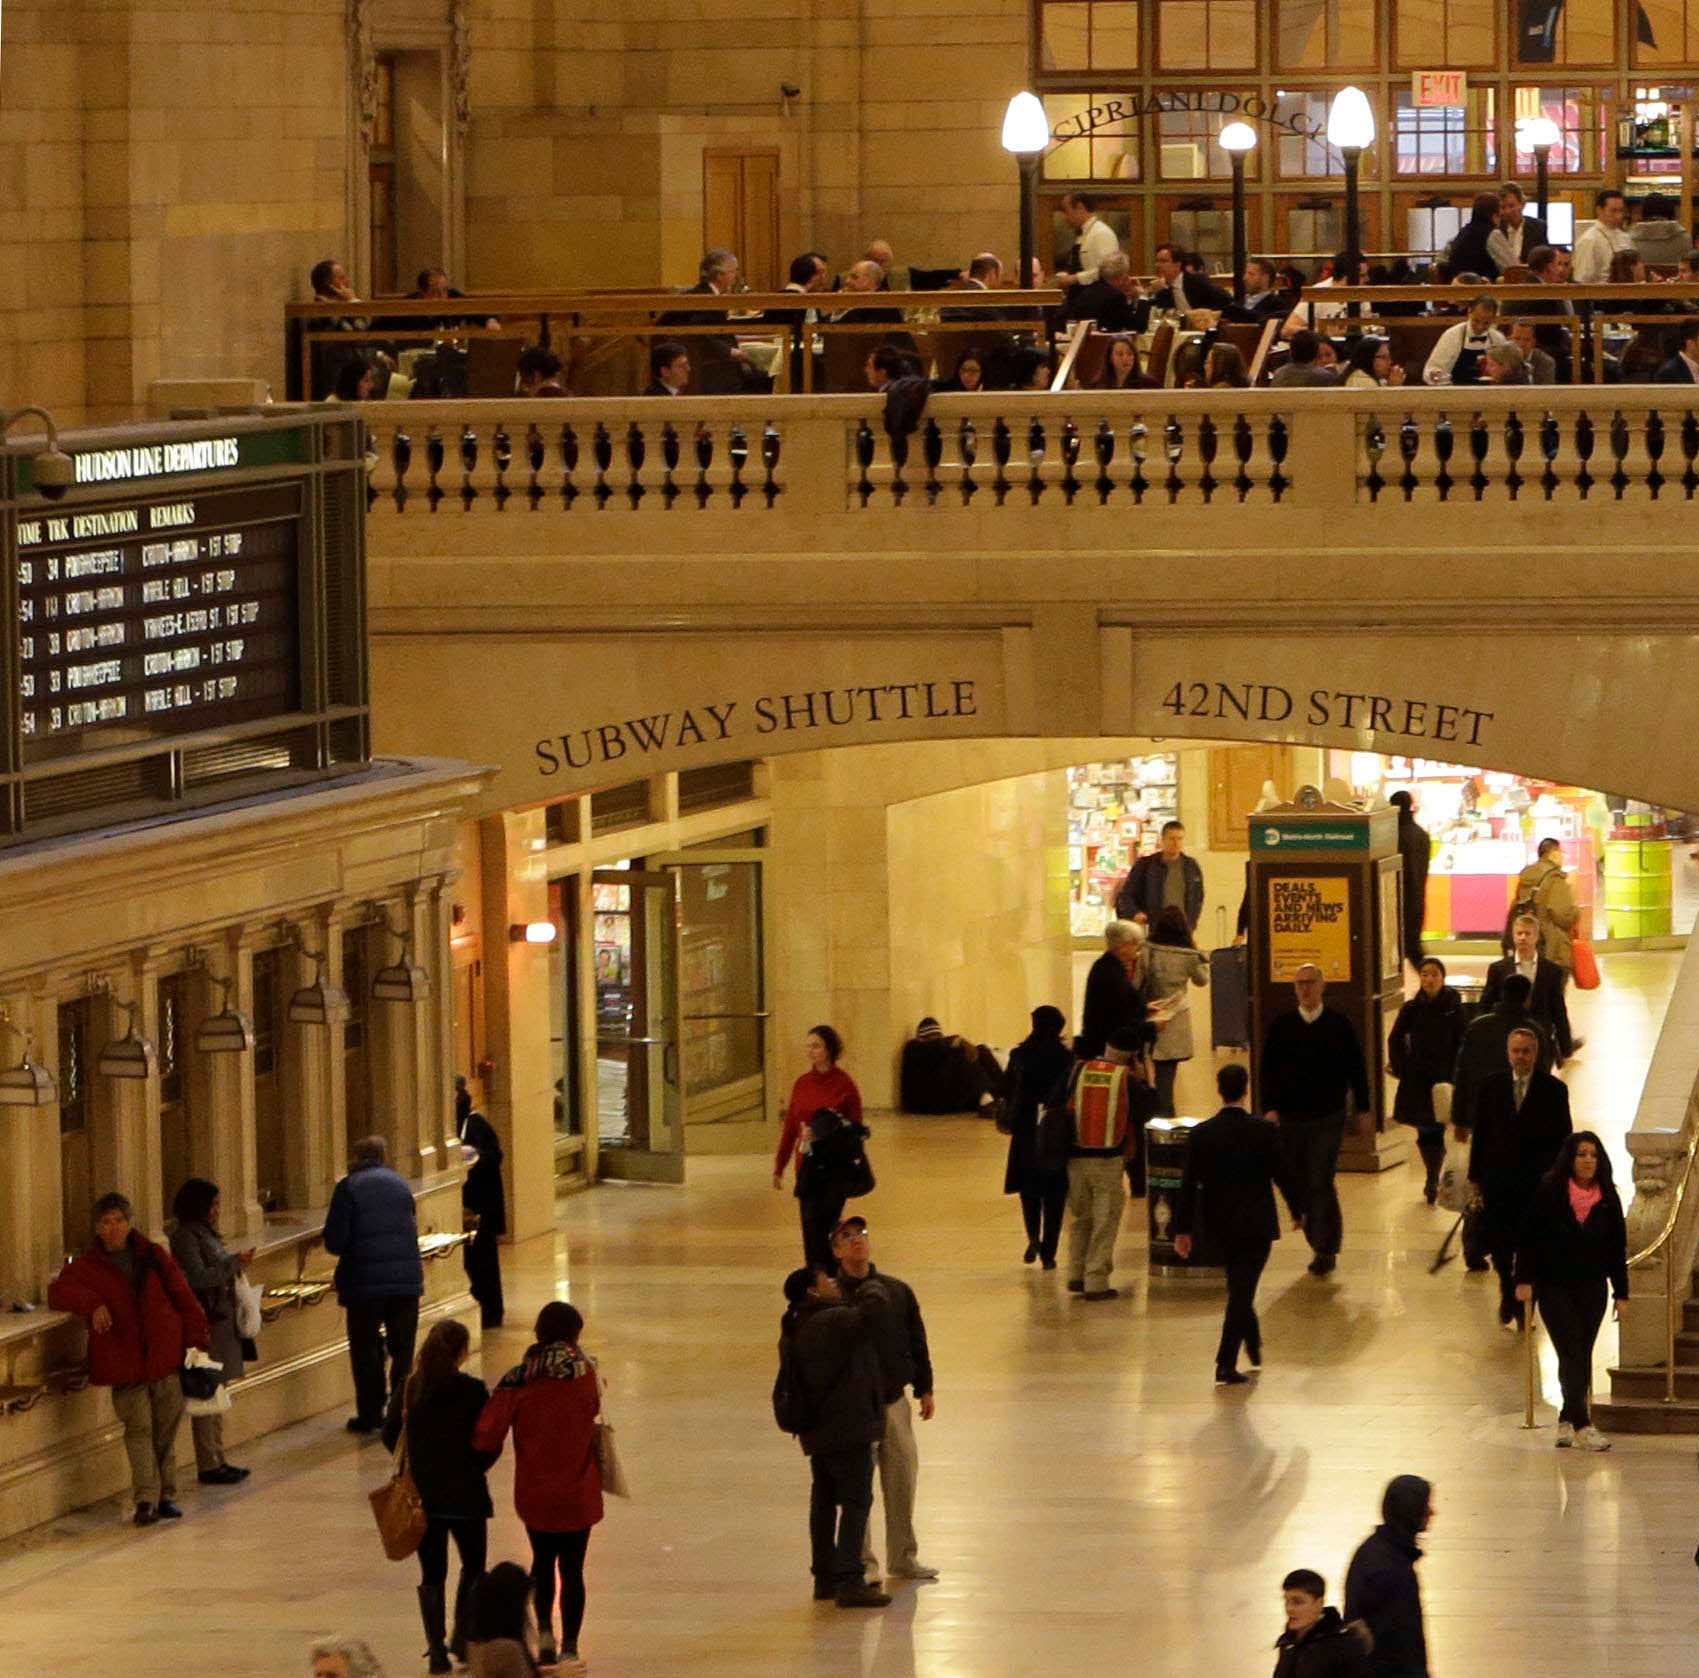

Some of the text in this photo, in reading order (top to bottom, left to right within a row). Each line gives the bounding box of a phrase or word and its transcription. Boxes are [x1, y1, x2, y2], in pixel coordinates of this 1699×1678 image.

[1420, 75, 1461, 104] EXIT
[1053, 92, 1208, 142] CIPRIANI
[75, 438, 239, 482] HUDSON LINE DEPARTURES
[48, 518, 70, 542] TRK
[73, 510, 138, 538] DESTINATION
[150, 503, 195, 528] REMARKS
[535, 680, 978, 776] SUBWAY SHUTTLE
[1162, 682, 1494, 747] 42ND STREET
[1273, 902, 1344, 914] AND NEWS
[1273, 912, 1338, 923] ARRIVING
